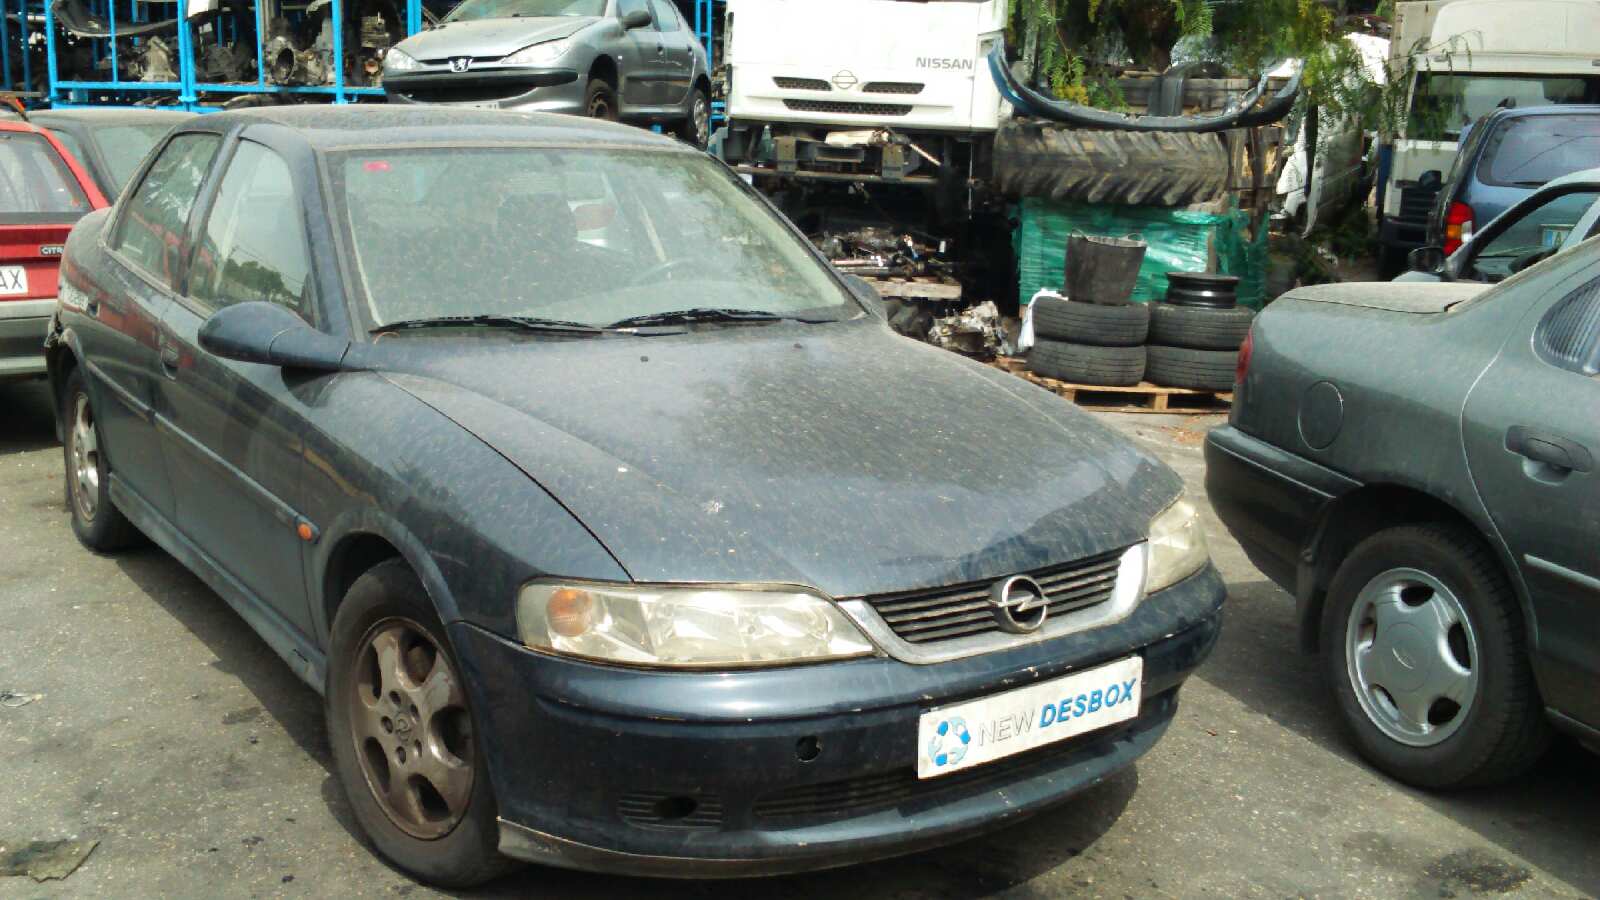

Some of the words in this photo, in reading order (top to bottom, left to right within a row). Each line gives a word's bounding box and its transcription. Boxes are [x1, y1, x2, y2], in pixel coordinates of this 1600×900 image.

[915, 57, 973, 70] NISSAN
[976, 709, 1035, 747] NEW
[1039, 677, 1137, 728] DESBOX
